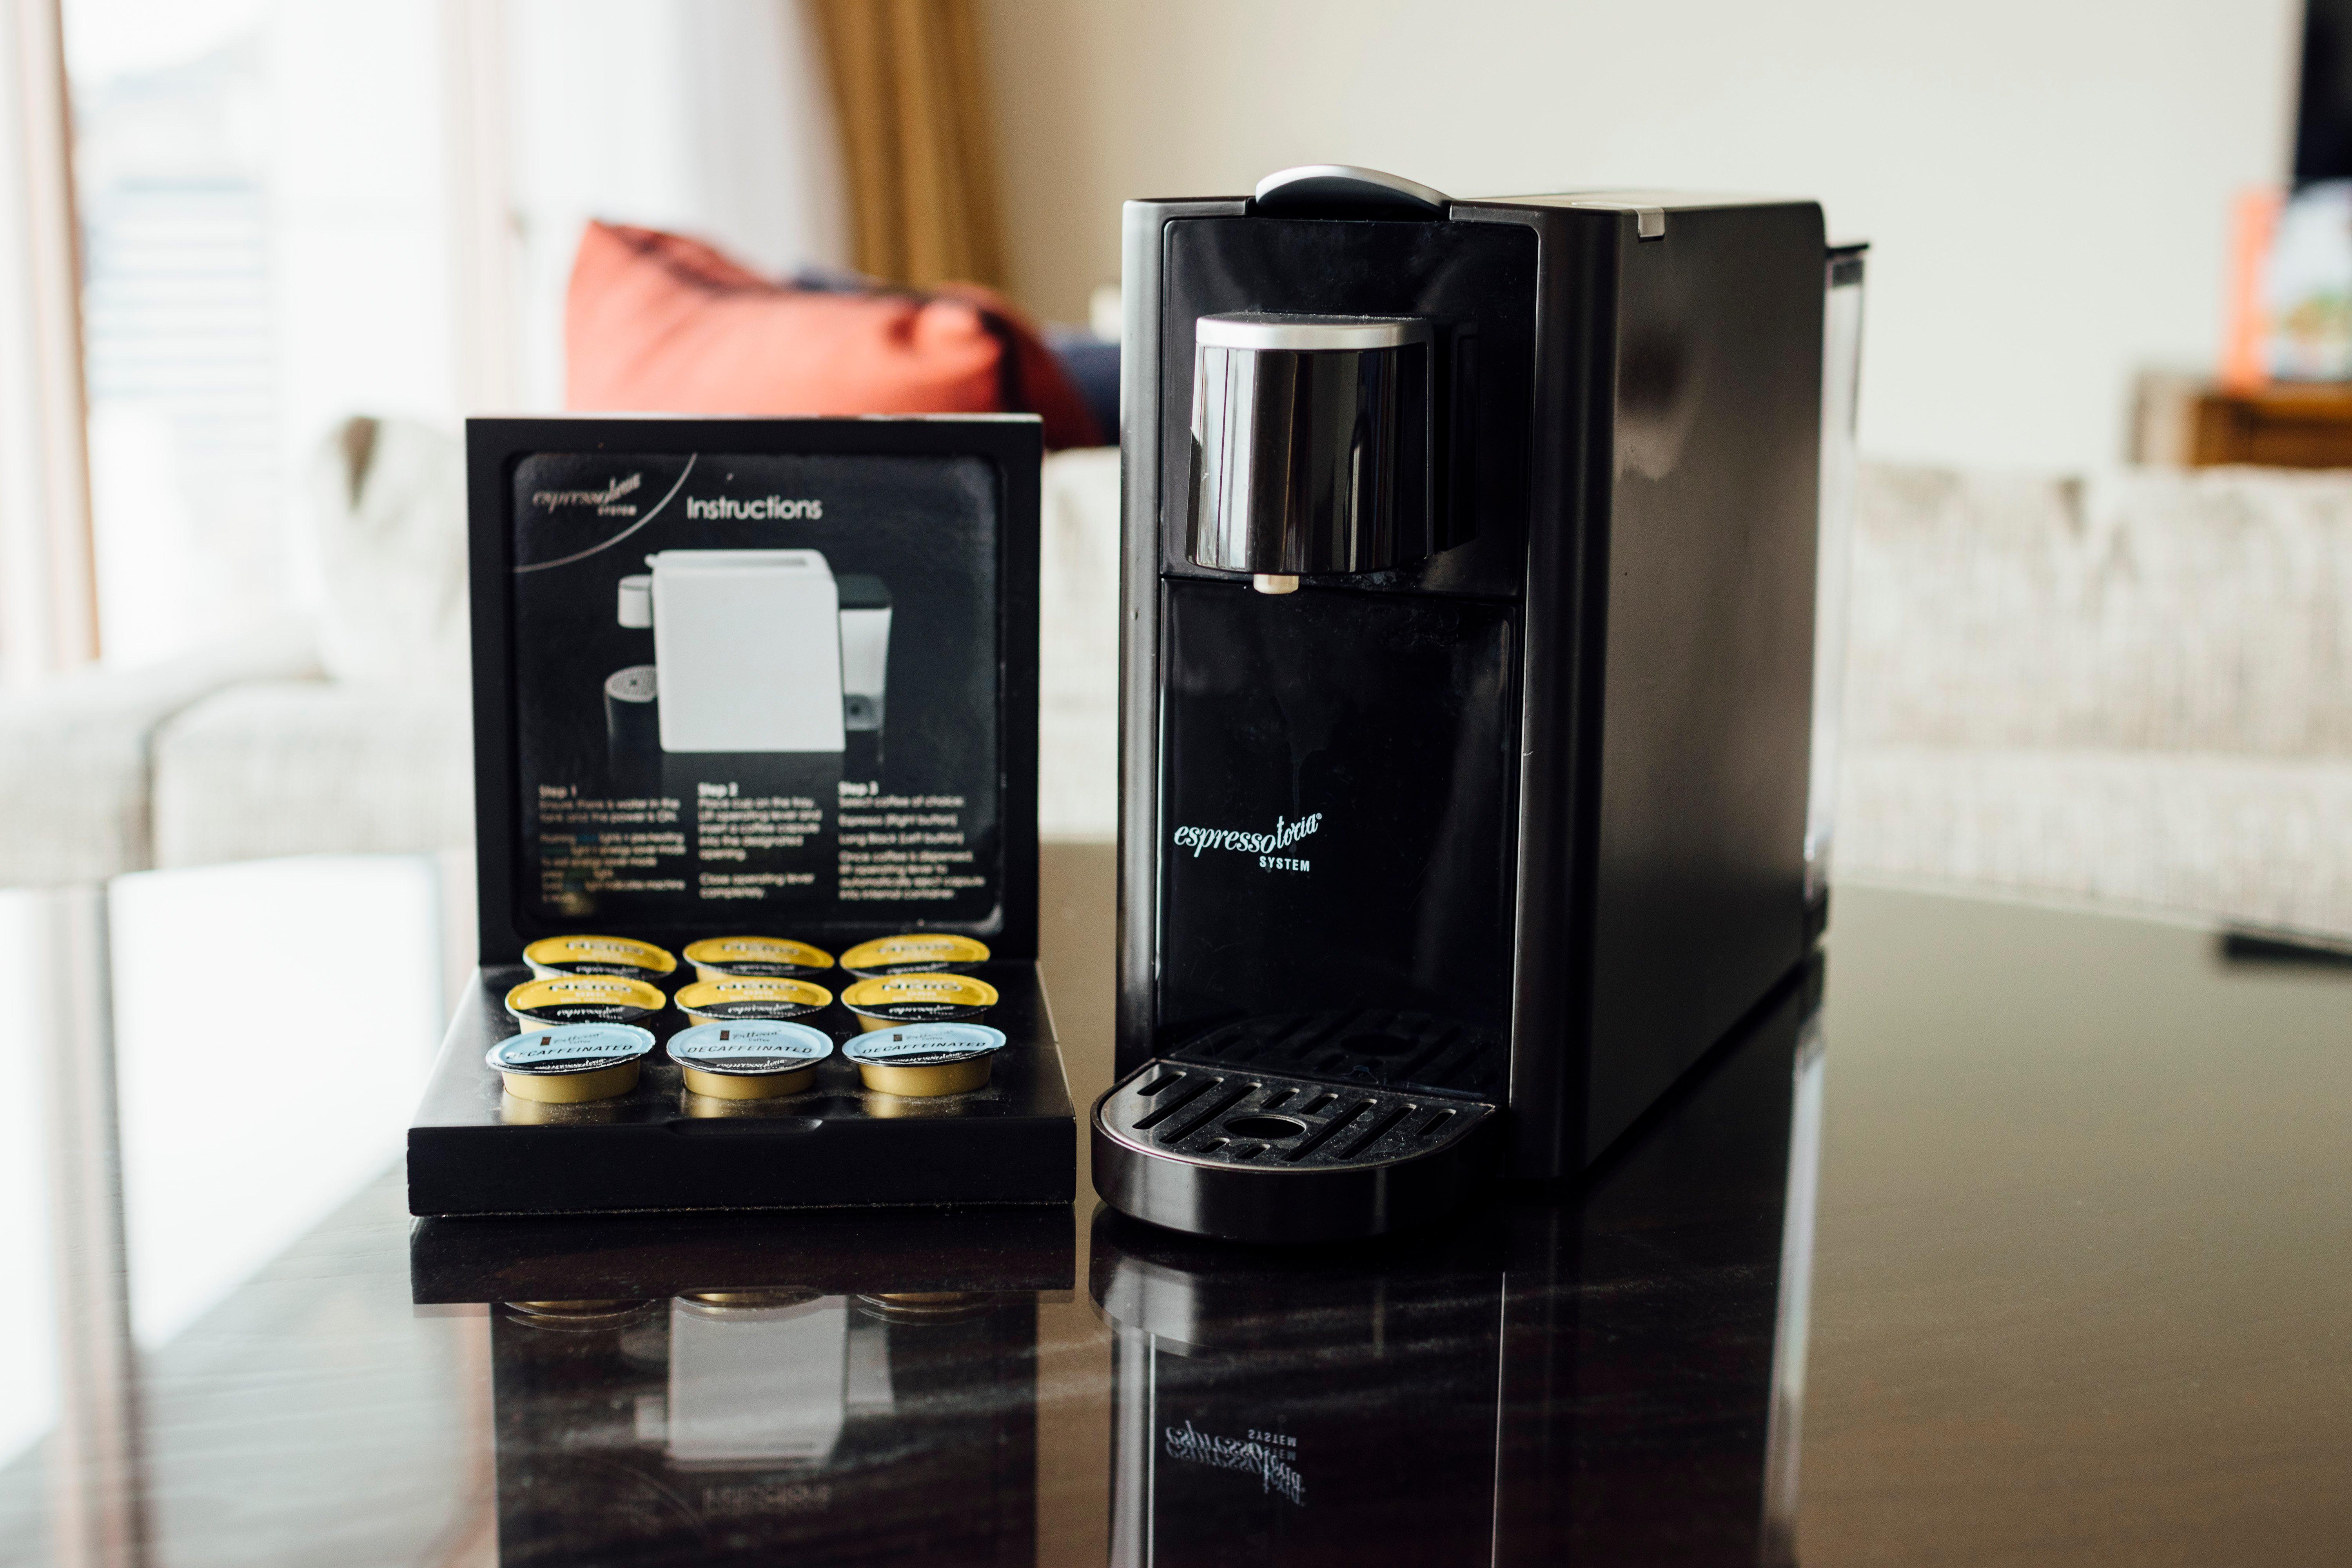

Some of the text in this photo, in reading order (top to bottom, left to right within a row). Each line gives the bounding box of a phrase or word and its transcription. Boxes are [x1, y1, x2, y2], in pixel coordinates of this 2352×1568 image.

[687, 495, 822, 519] Instructions
[698, 782, 739, 798] Step 2
[838, 780, 879, 796] Step 3
[1259, 856, 1310, 872] SYSTEM
[505, 1044, 634, 1059] DECAFFEINATED
[687, 1045, 813, 1054] DECAFFEINATED
[862, 1042, 987, 1054] DECAFFEINATED
